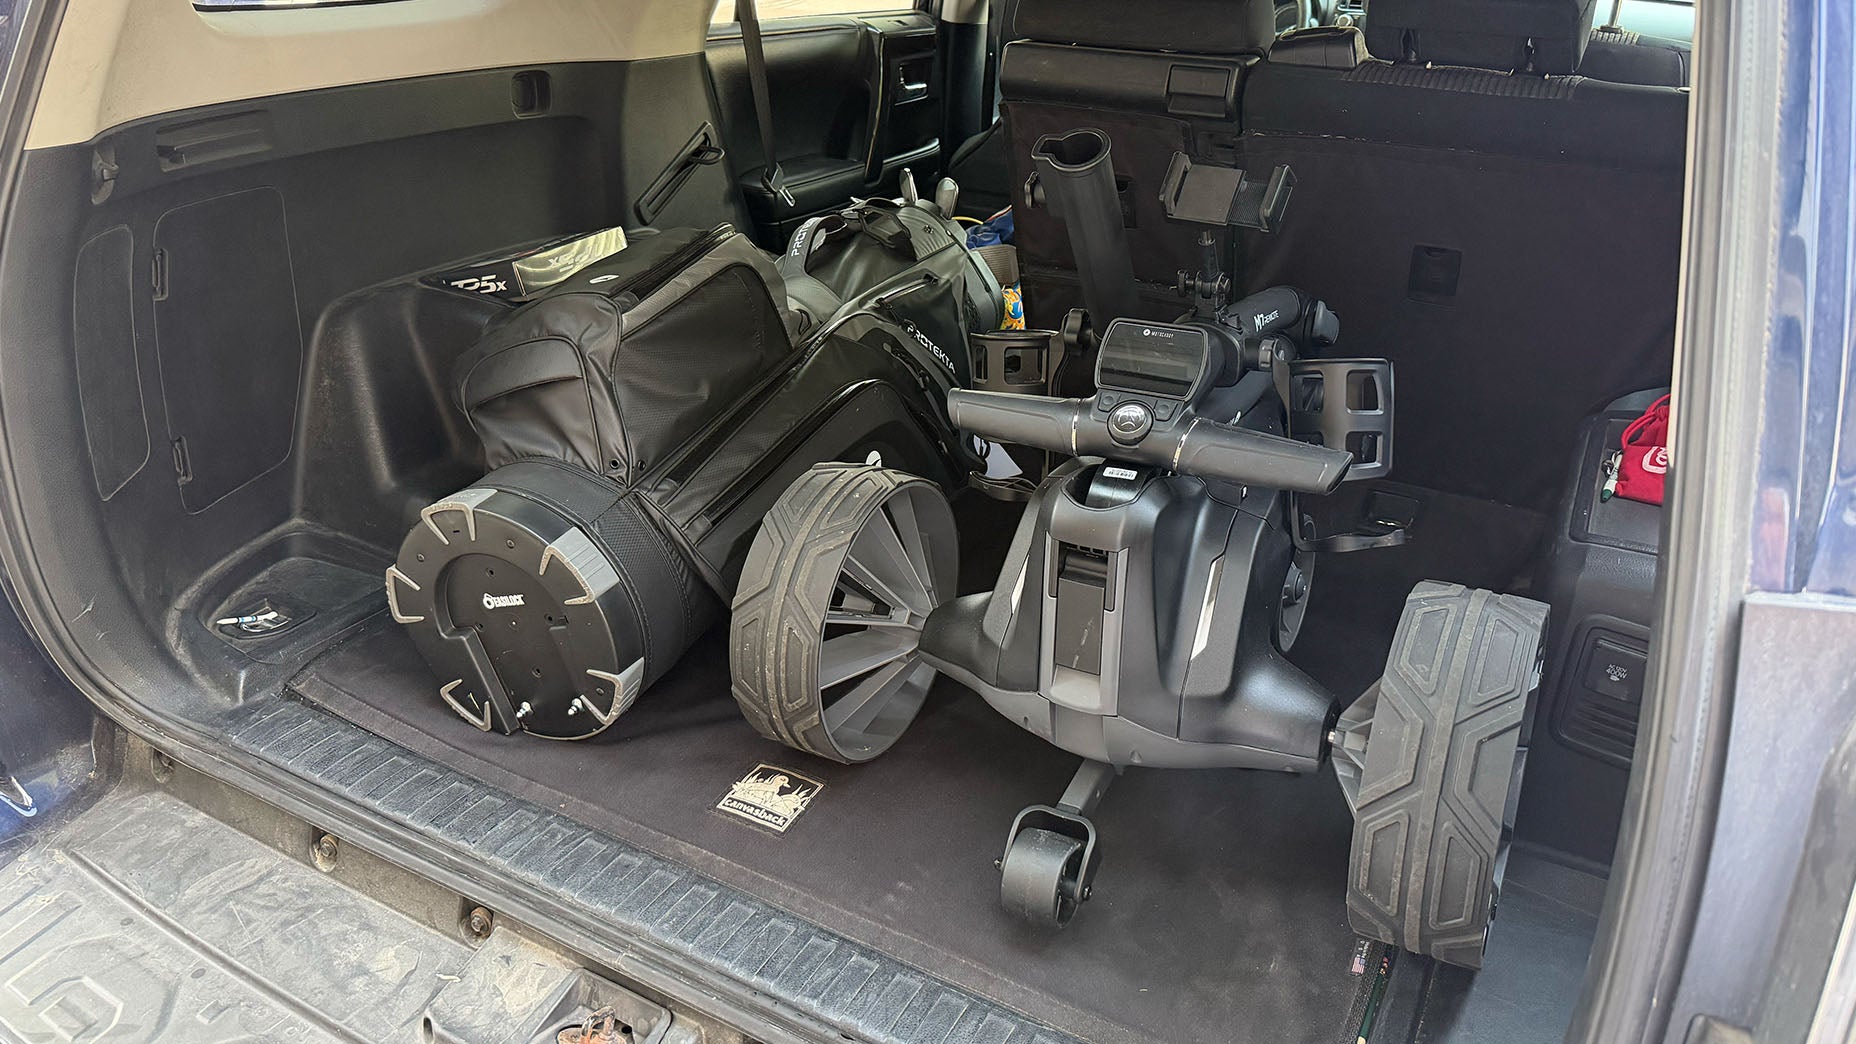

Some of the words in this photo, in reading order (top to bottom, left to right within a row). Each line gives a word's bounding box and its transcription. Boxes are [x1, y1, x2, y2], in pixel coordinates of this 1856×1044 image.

[907, 325, 956, 374] PROTEKTA
[1606, 668, 1627, 679] 400W
[724, 798, 786, 826] canvasback
